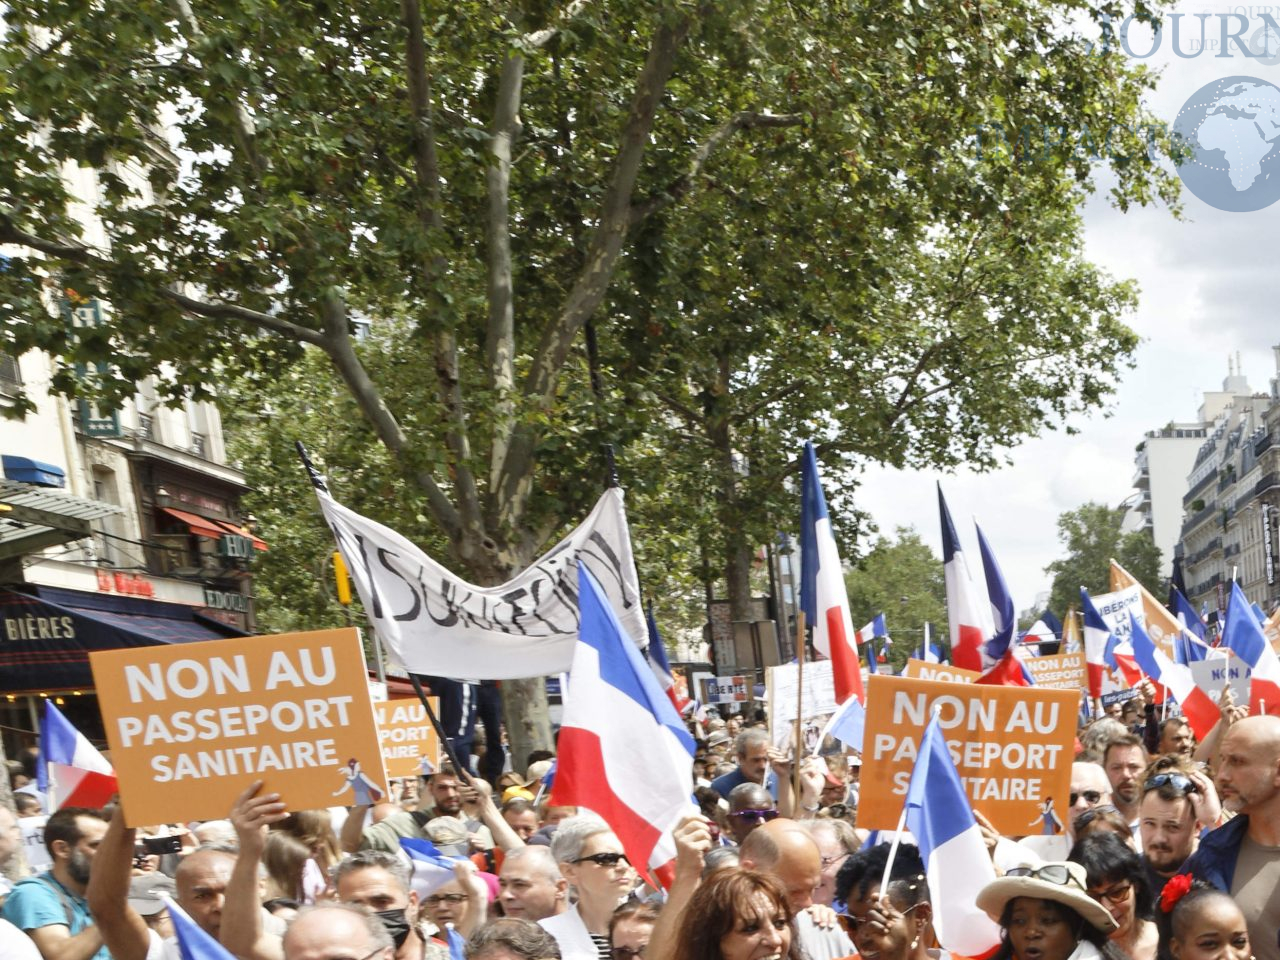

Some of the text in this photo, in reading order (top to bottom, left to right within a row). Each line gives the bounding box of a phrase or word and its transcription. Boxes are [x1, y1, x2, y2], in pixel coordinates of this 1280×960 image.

[5, 613, 76, 640] BIÈRES
[124, 646, 336, 704] NON AU
[1027, 656, 1081, 671] NON AU
[1031, 667, 1084, 683] ASSEPORT
[117, 695, 353, 748] PASSEPORT
[391, 704, 427, 724] AU
[893, 691, 1060, 735] NON AU
[151, 739, 340, 783] SANITAIRE
[873, 733, 1064, 770] PASEPORT
[891, 771, 1041, 801] SITAIRE
